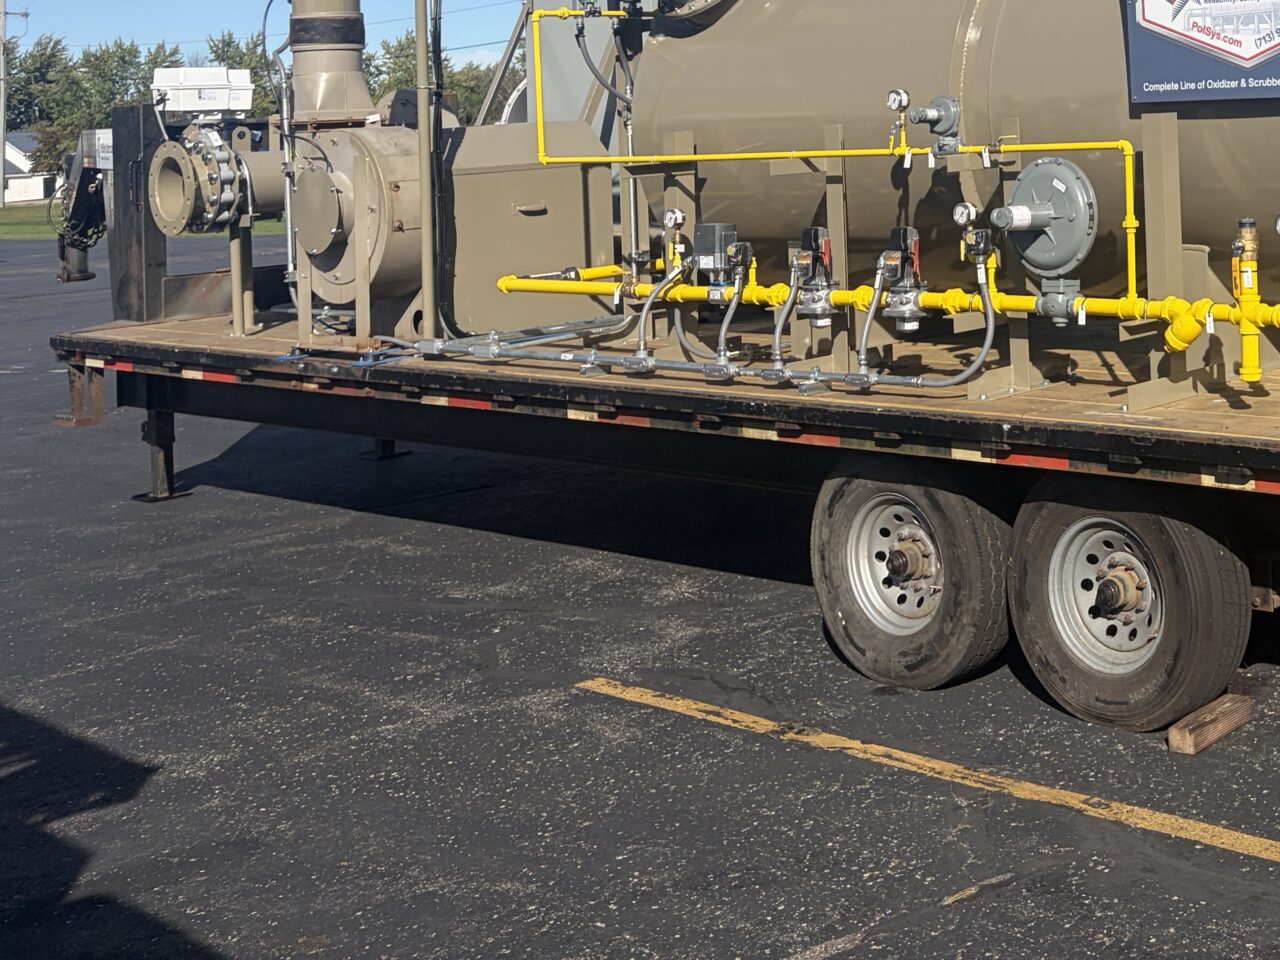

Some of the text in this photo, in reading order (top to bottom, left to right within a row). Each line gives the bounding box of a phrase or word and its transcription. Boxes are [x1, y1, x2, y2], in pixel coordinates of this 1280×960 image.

[1191, 21, 1243, 49] PolSys.com
[1254, 30, 1275, 49] (713)
[1143, 81, 1179, 93] Complete
[1180, 80, 1196, 90] Line
[1197, 79, 1206, 90] of
[1206, 78, 1239, 89] Oxidizer
[1240, 78, 1247, 88] &
